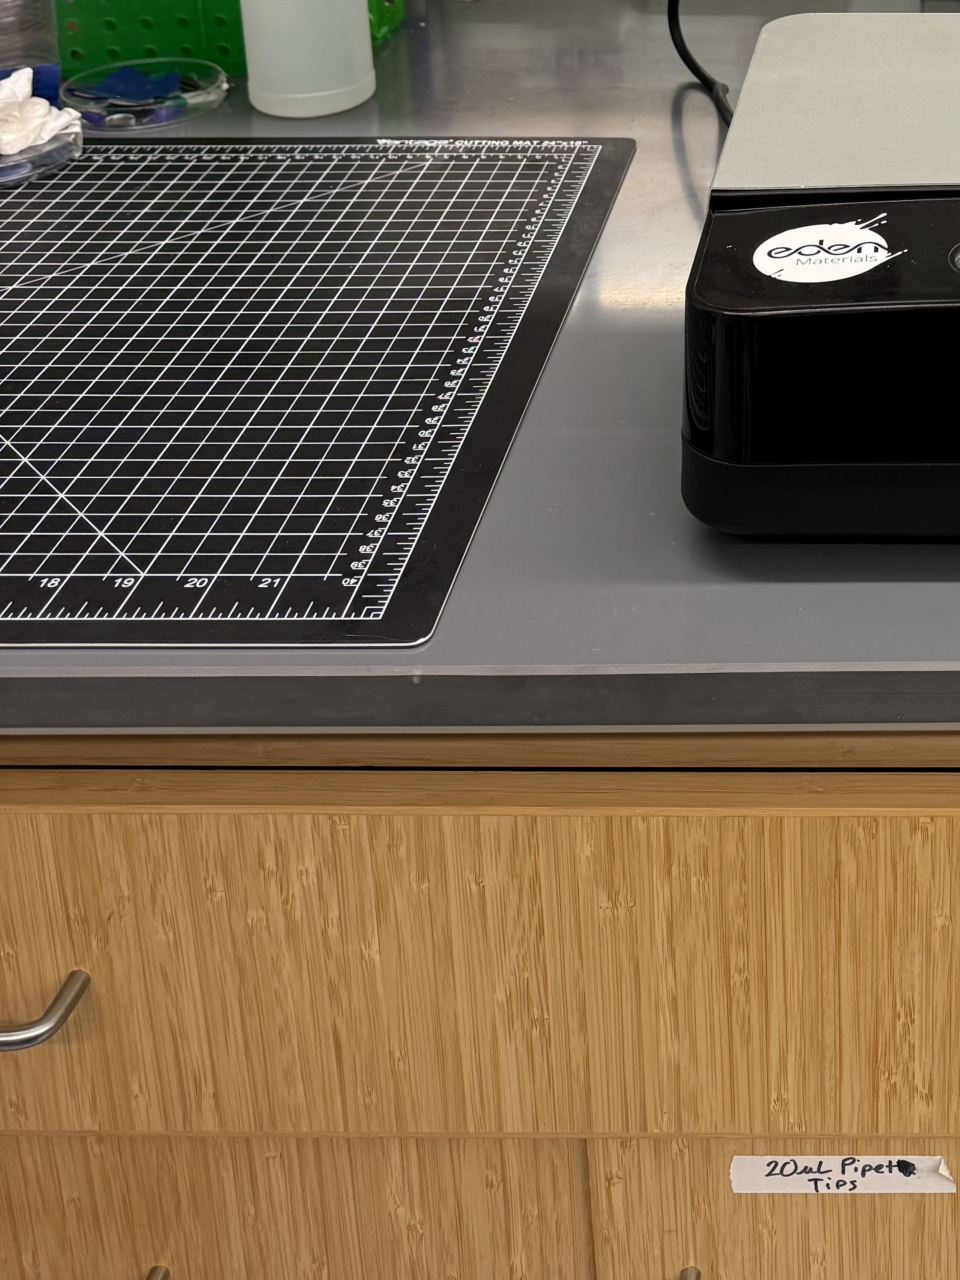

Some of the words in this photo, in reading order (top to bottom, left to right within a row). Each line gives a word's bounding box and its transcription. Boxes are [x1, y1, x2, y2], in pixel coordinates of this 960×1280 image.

[795, 254, 878, 267] Materials
[39, 578, 60, 588] 18
[113, 578, 135, 588] 19
[184, 578, 209, 588] 20
[258, 578, 280, 588] 21
[808, 1177, 857, 1193] Tips
